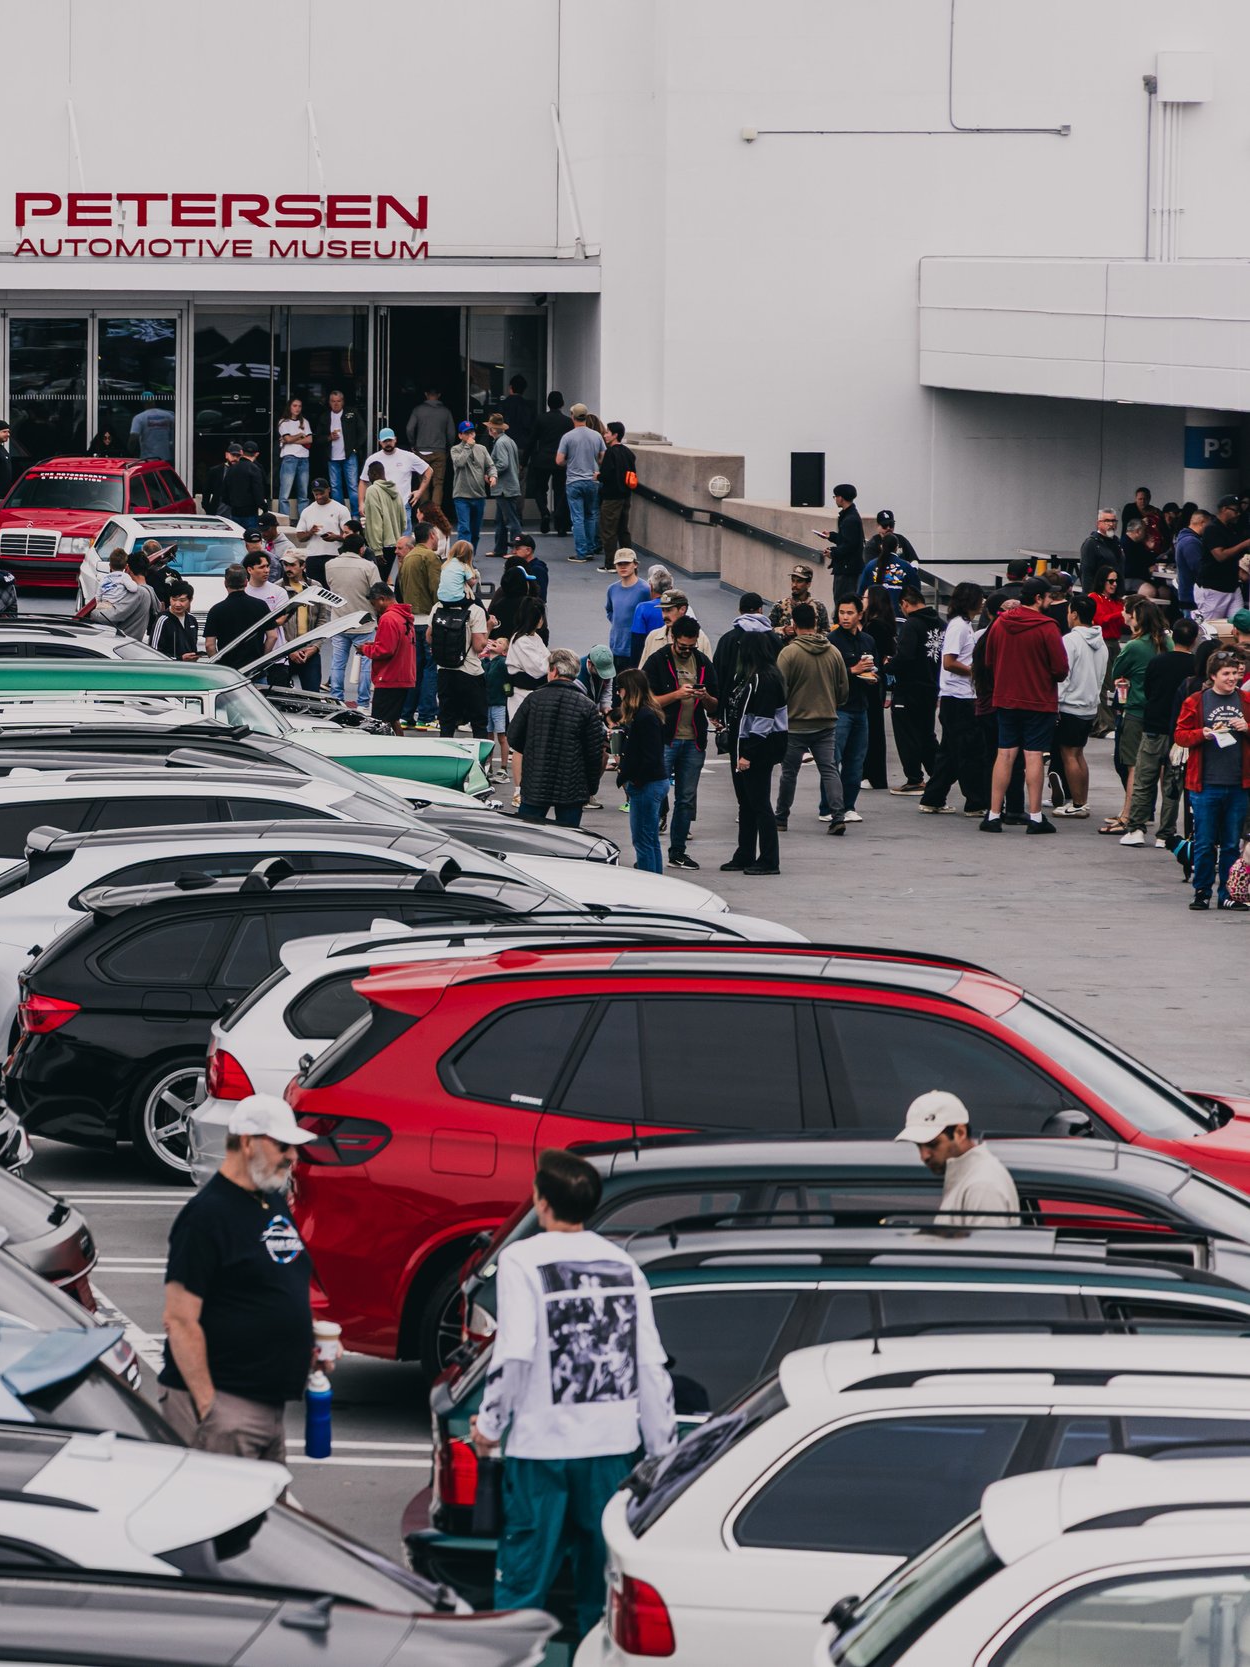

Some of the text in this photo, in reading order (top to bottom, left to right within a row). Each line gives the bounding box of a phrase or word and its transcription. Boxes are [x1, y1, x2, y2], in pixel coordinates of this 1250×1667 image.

[14, 192, 429, 230] PETERSEN
[13, 237, 430, 260] AUTOMOTIVE MUSEUM
[1203, 438, 1232, 459] P3
[1207, 705, 1225, 721] LUCKY
